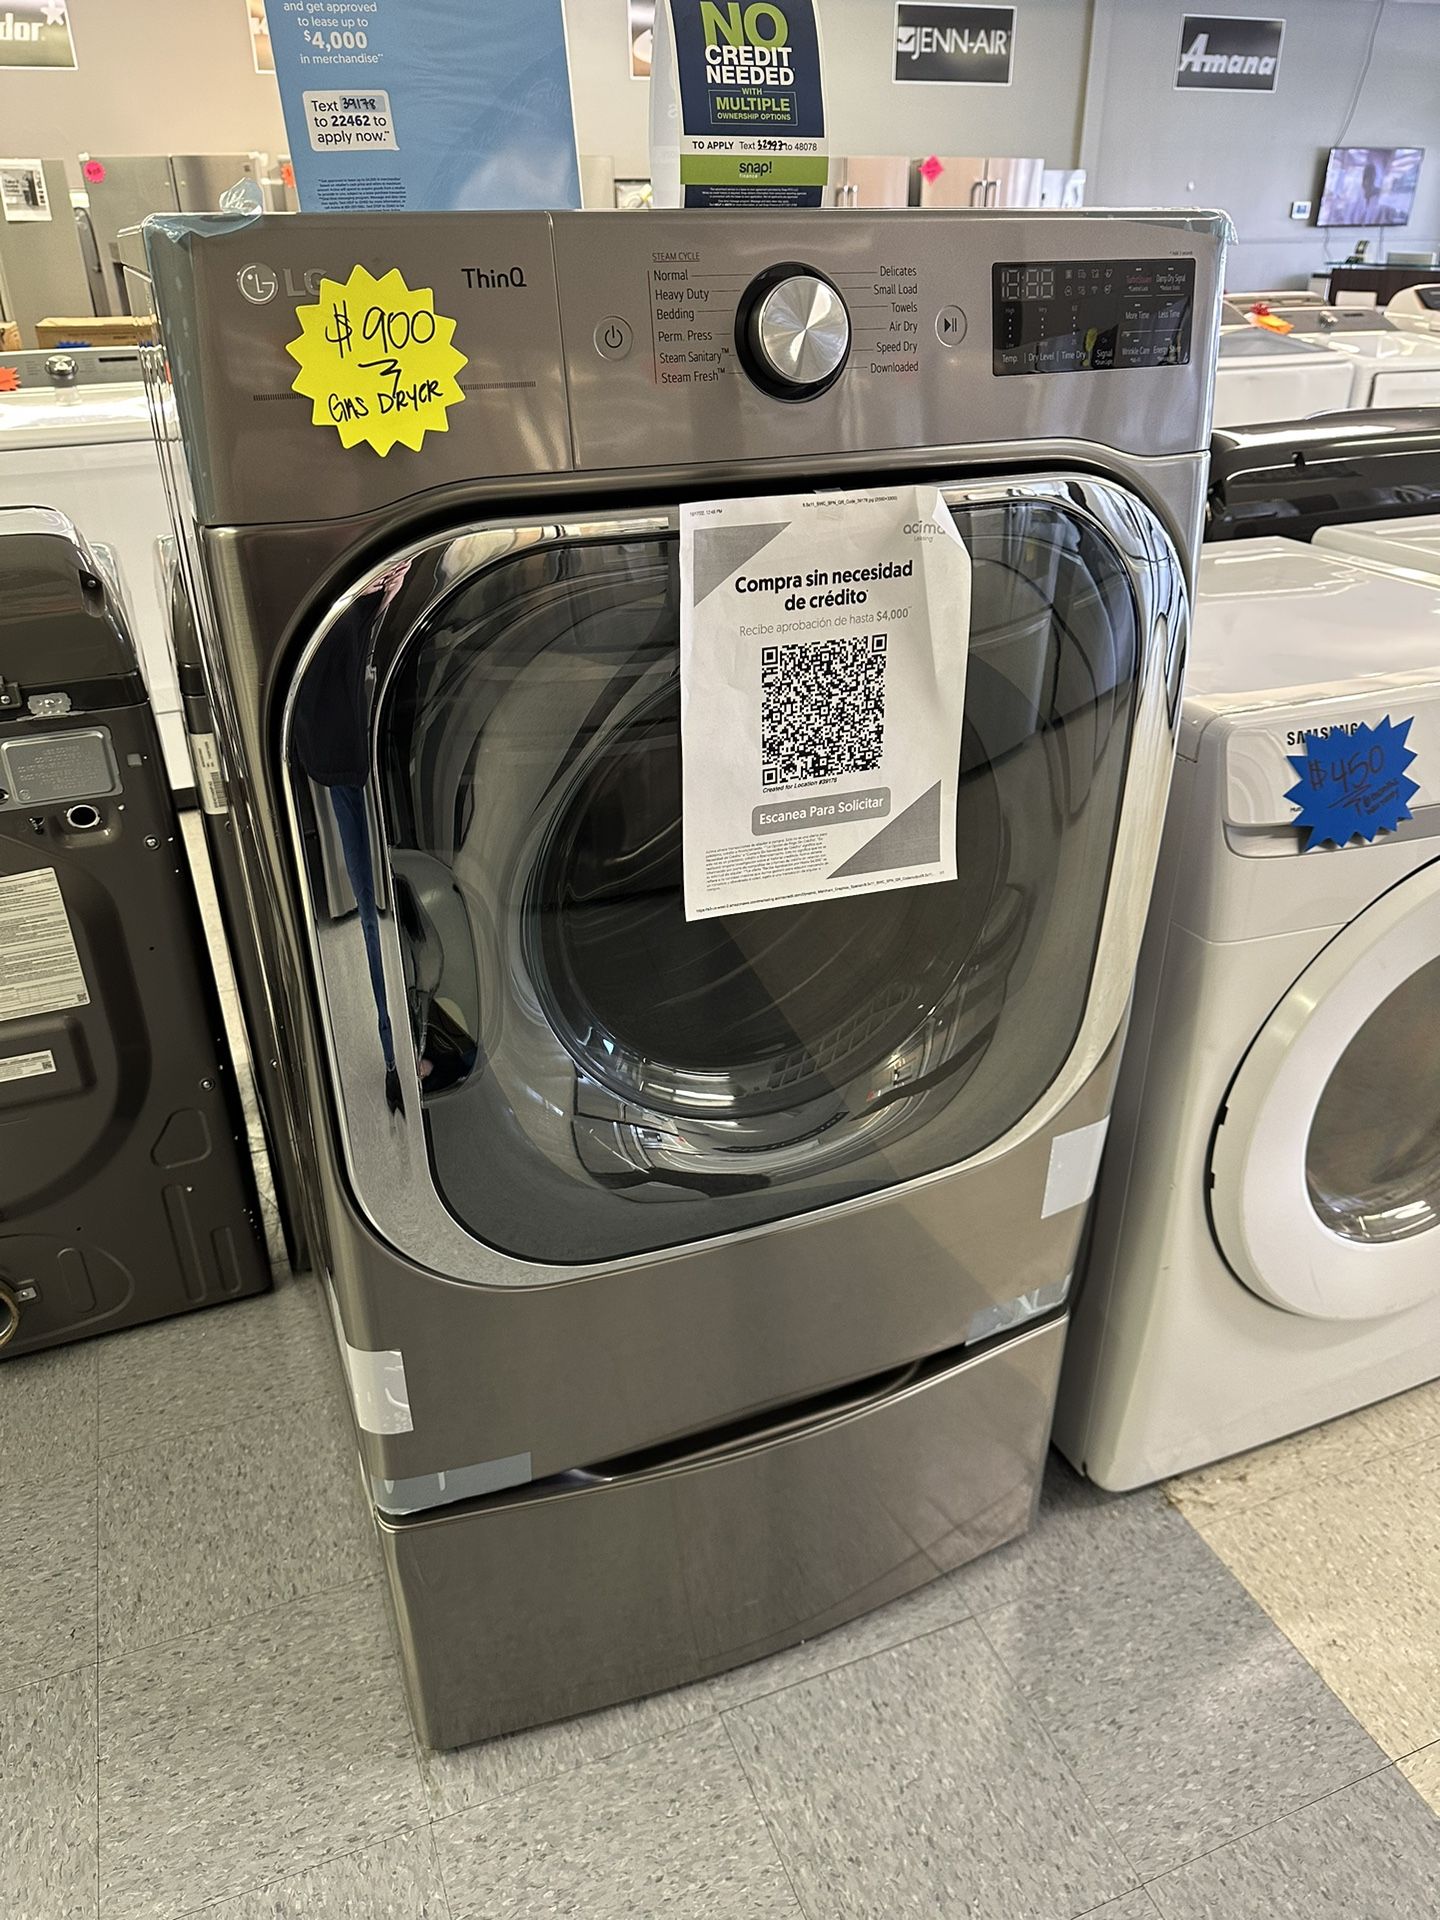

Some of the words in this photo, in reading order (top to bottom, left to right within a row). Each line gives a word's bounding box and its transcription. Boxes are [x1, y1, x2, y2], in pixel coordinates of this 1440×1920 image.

[284, 2, 304, 11] and
[306, 3, 324, 13] get
[327, 2, 377, 14] approved
[297, 17, 309, 26] to
[312, 16, 339, 27] lease
[341, 19, 355, 28] up
[357, 18, 369, 27] to
[700, 1, 789, 50] NO
[304, 29, 368, 52] $4,000
[911, 26, 1007, 60] JENN-AIR
[300, 54, 310, 64] in
[705, 45, 792, 66] CREDIT
[1178, 33, 1276, 75] Amana
[311, 100, 339, 112] Text
[342, 97, 376, 110] 39178
[716, 97, 790, 112] MULTIPLE
[314, 117, 328, 127] to
[331, 115, 371, 127] 22462
[373, 116, 387, 127] to
[717, 112, 759, 120] OWNERSHIP
[318, 130, 352, 145] apply
[692, 141, 705, 149] TO
[707, 141, 735, 150] APPLY
[740, 142, 755, 150] Text
[795, 142, 817, 151] 48078
[739, 161, 772, 176] snap!
[652, 252, 677, 260] STEAM
[678, 252, 700, 260] CYCLE
[461, 266, 527, 289] ThinQ
[653, 269, 688, 281] Normal
[880, 265, 917, 277] Delicates
[283, 268, 328, 297] LG
[873, 284, 896, 295] Small
[898, 283, 918, 295] Load
[655, 289, 684, 302] Heavy
[687, 288, 709, 302] Duty
[891, 301, 918, 313] Towels
[657, 308, 695, 322] Bedding
[1125, 311, 1137, 320] More
[1138, 311, 1150, 319] Time
[1158, 311, 1168, 319] Less
[889, 321, 901, 332] Air
[904, 321, 918, 334] Dry
[687, 330, 713, 341] Press
[876, 341, 901, 354] Speed
[903, 341, 918, 354] Dry
[1096, 349, 1113, 359] Signal
[660, 352, 686, 364] Steam
[1028, 353, 1038, 363] Dry
[1040, 352, 1055, 360] Level
[1061, 352, 1075, 360] Time
[1076, 351, 1087, 360] Dry
[870, 361, 919, 374] Downloaded
[661, 372, 691, 384] Steam
[328, 393, 369, 423] GAS
[735, 574, 802, 594] Compra
[805, 569, 828, 587] sin
[832, 559, 913, 584] necesidad
[784, 594, 806, 611] de
[739, 624, 774, 637] Recibe
[776, 617, 832, 634] aprobación
[834, 615, 848, 626] de
[849, 612, 875, 624] hasta
[763, 784, 784, 794] Created
[794, 780, 818, 789] Location
[759, 809, 807, 825] Escanea
[809, 804, 835, 817] Para
[838, 797, 884, 813] Solicitar
